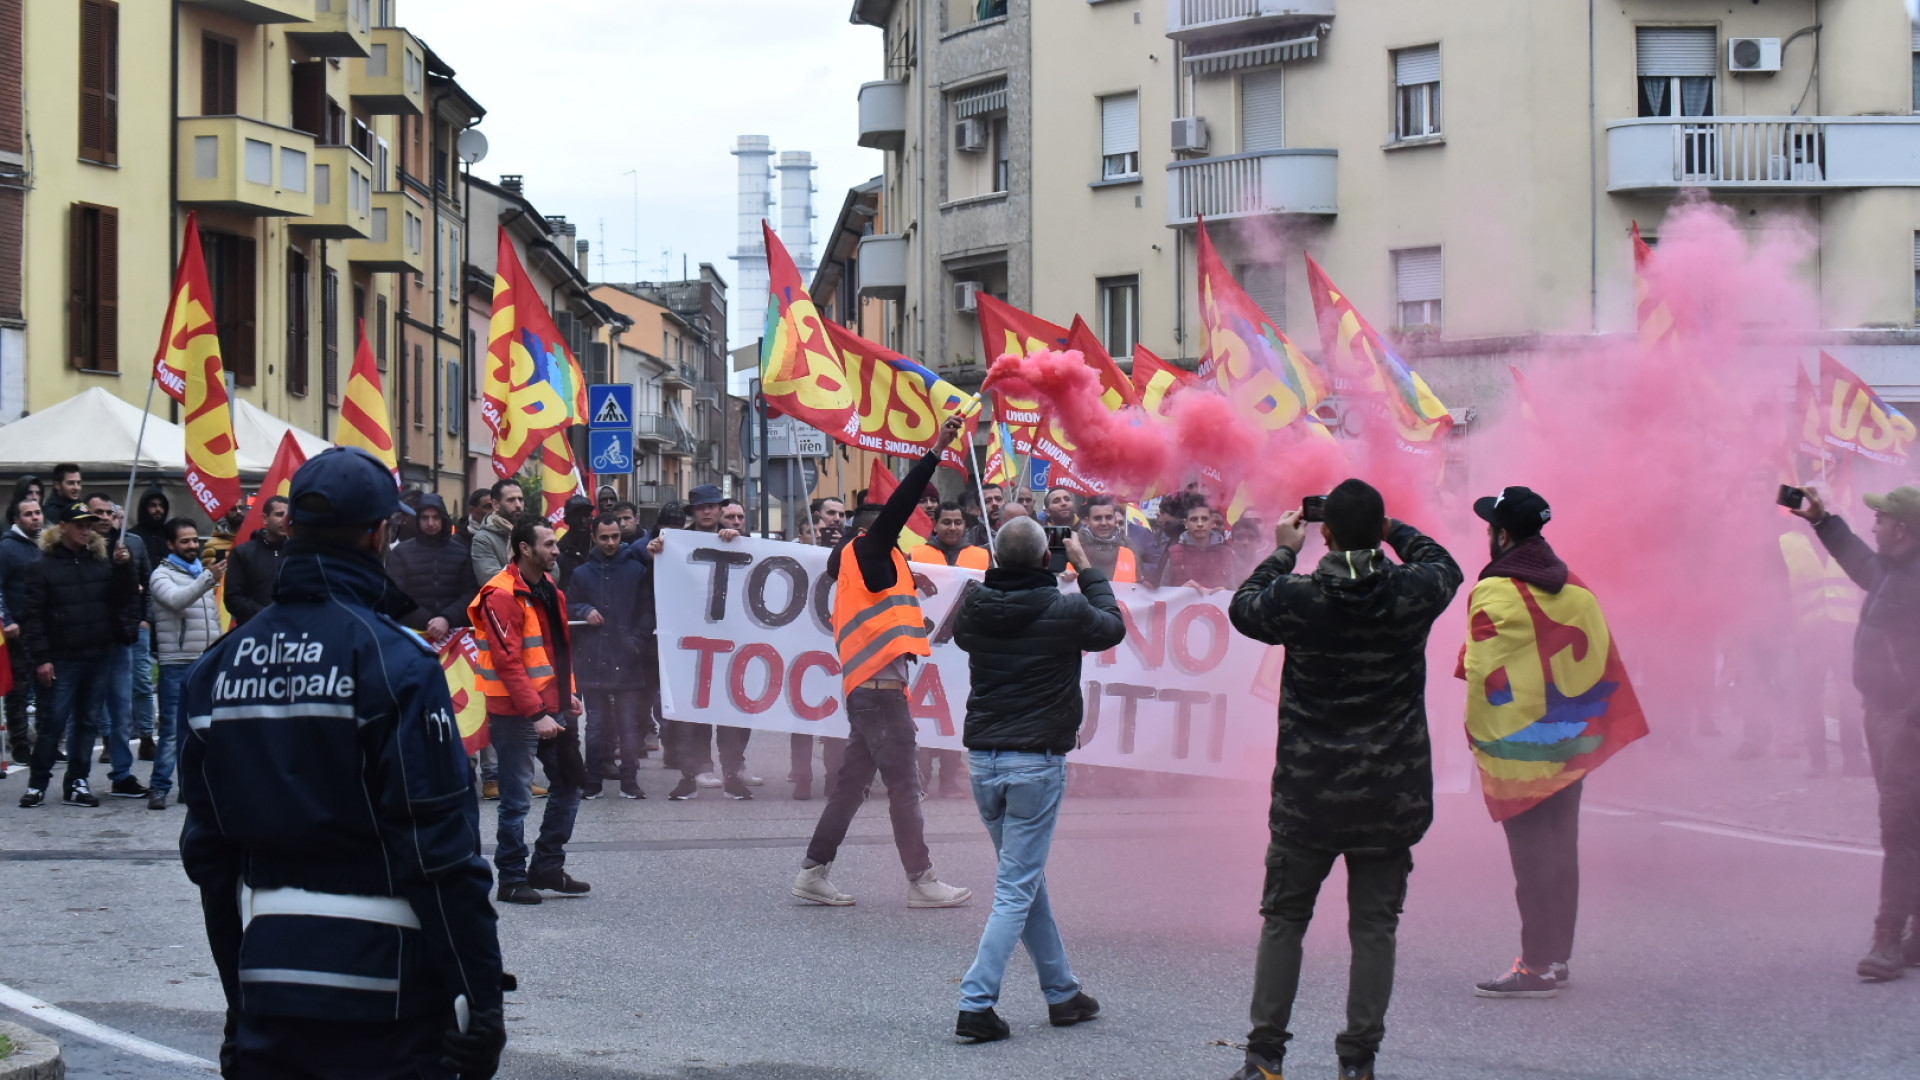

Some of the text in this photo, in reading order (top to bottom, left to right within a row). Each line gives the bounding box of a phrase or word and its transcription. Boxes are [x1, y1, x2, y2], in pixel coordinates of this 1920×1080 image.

[1006, 410, 1041, 422] UNION
[1037, 437, 1072, 469] UNIONE
[186, 471, 221, 513] BASE
[233, 633, 323, 667] Polizia
[213, 665, 355, 703] Municipale
[678, 636, 956, 737] TOCA
